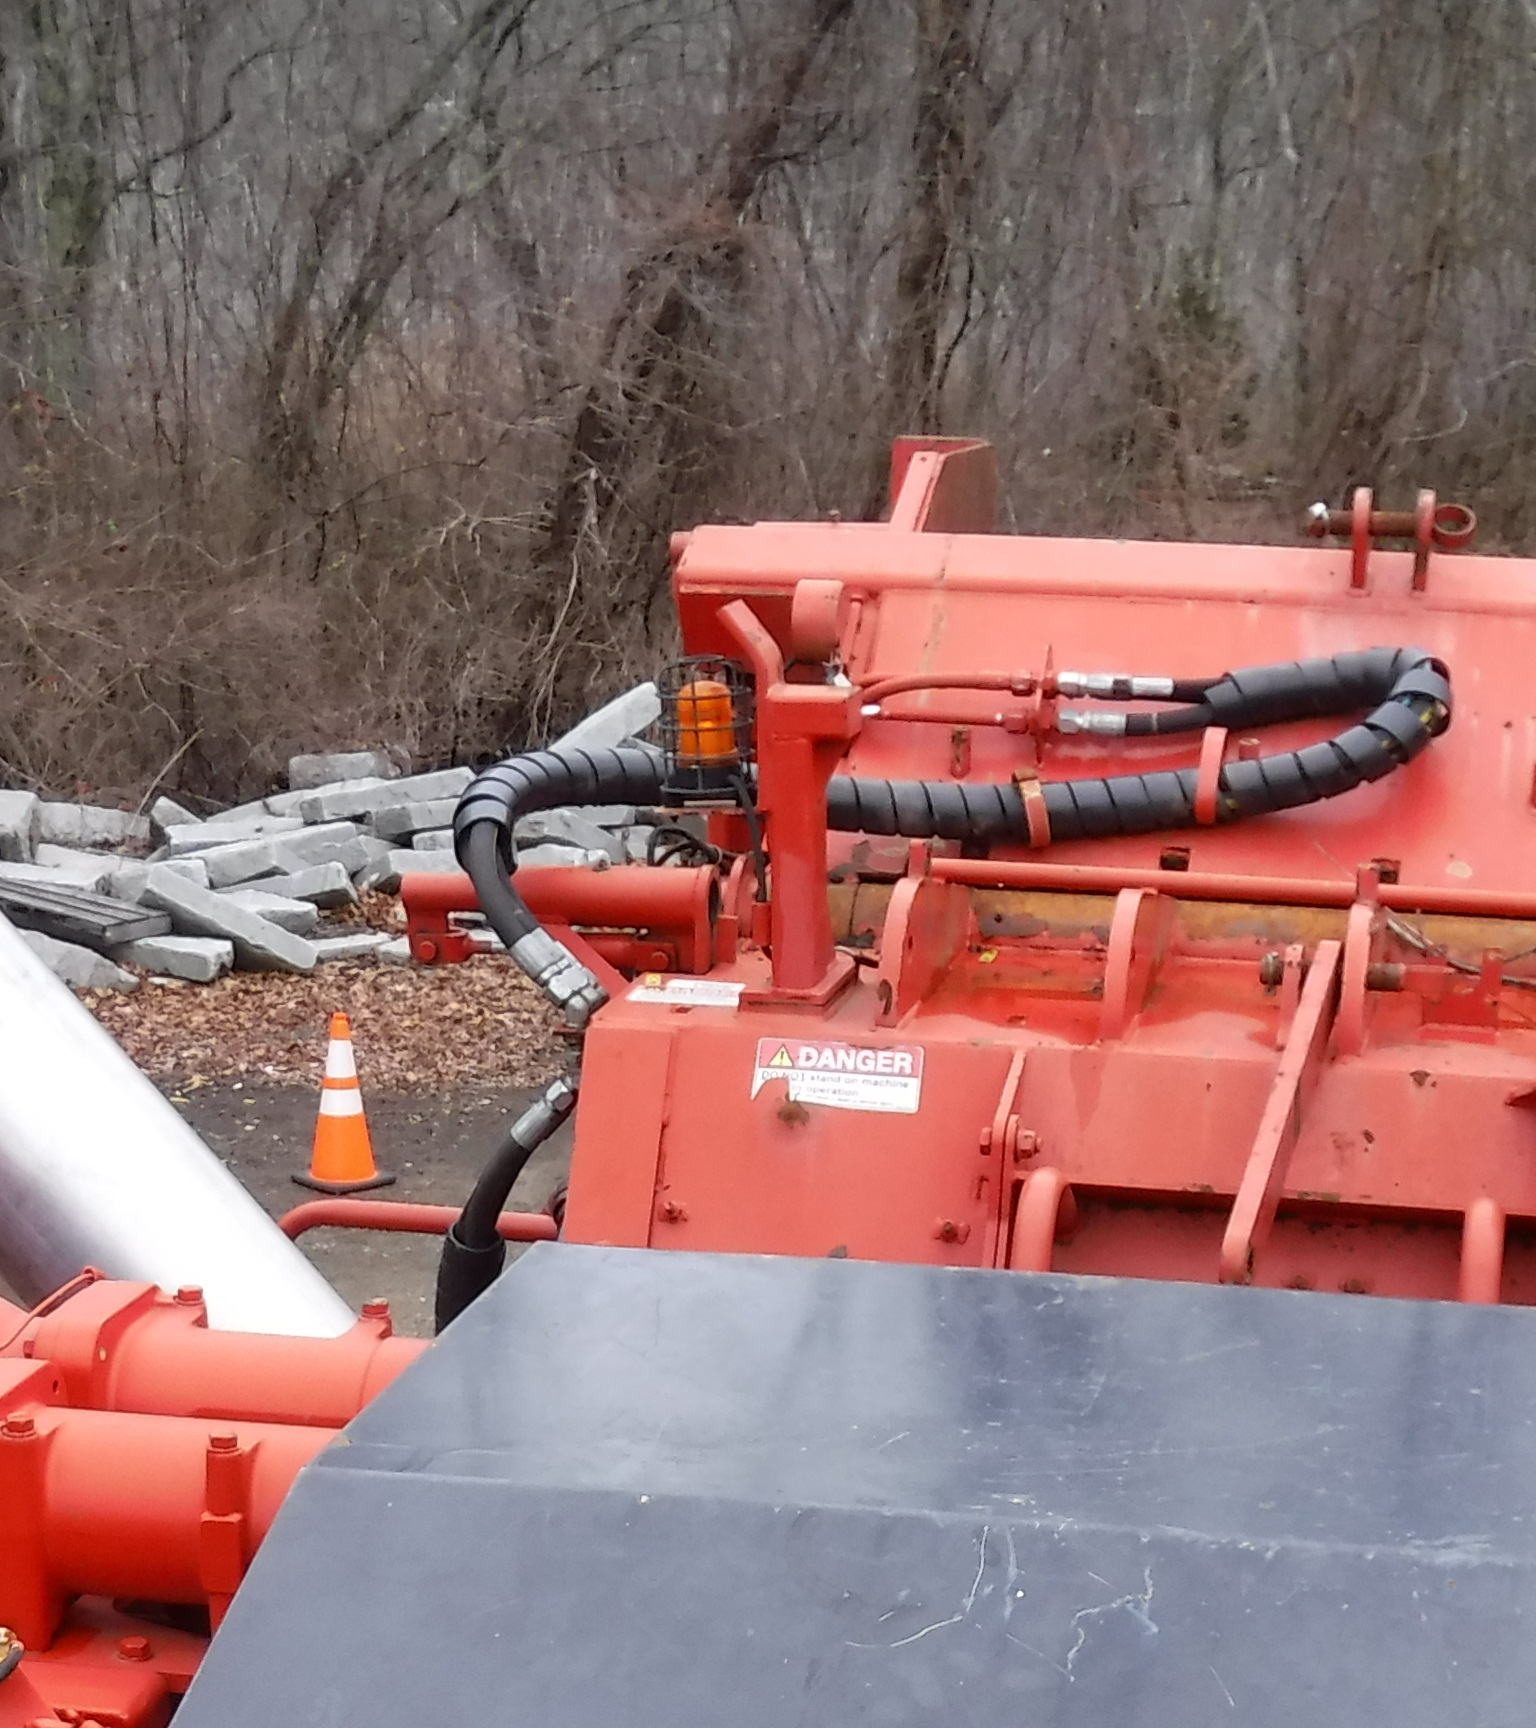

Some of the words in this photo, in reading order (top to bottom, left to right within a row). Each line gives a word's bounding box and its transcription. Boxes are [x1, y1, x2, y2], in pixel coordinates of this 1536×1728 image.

[798, 1046, 913, 1074] DANGER
[810, 1074, 841, 1084] stand
[861, 1078, 910, 1089] machine
[806, 1085, 859, 1097] operation
